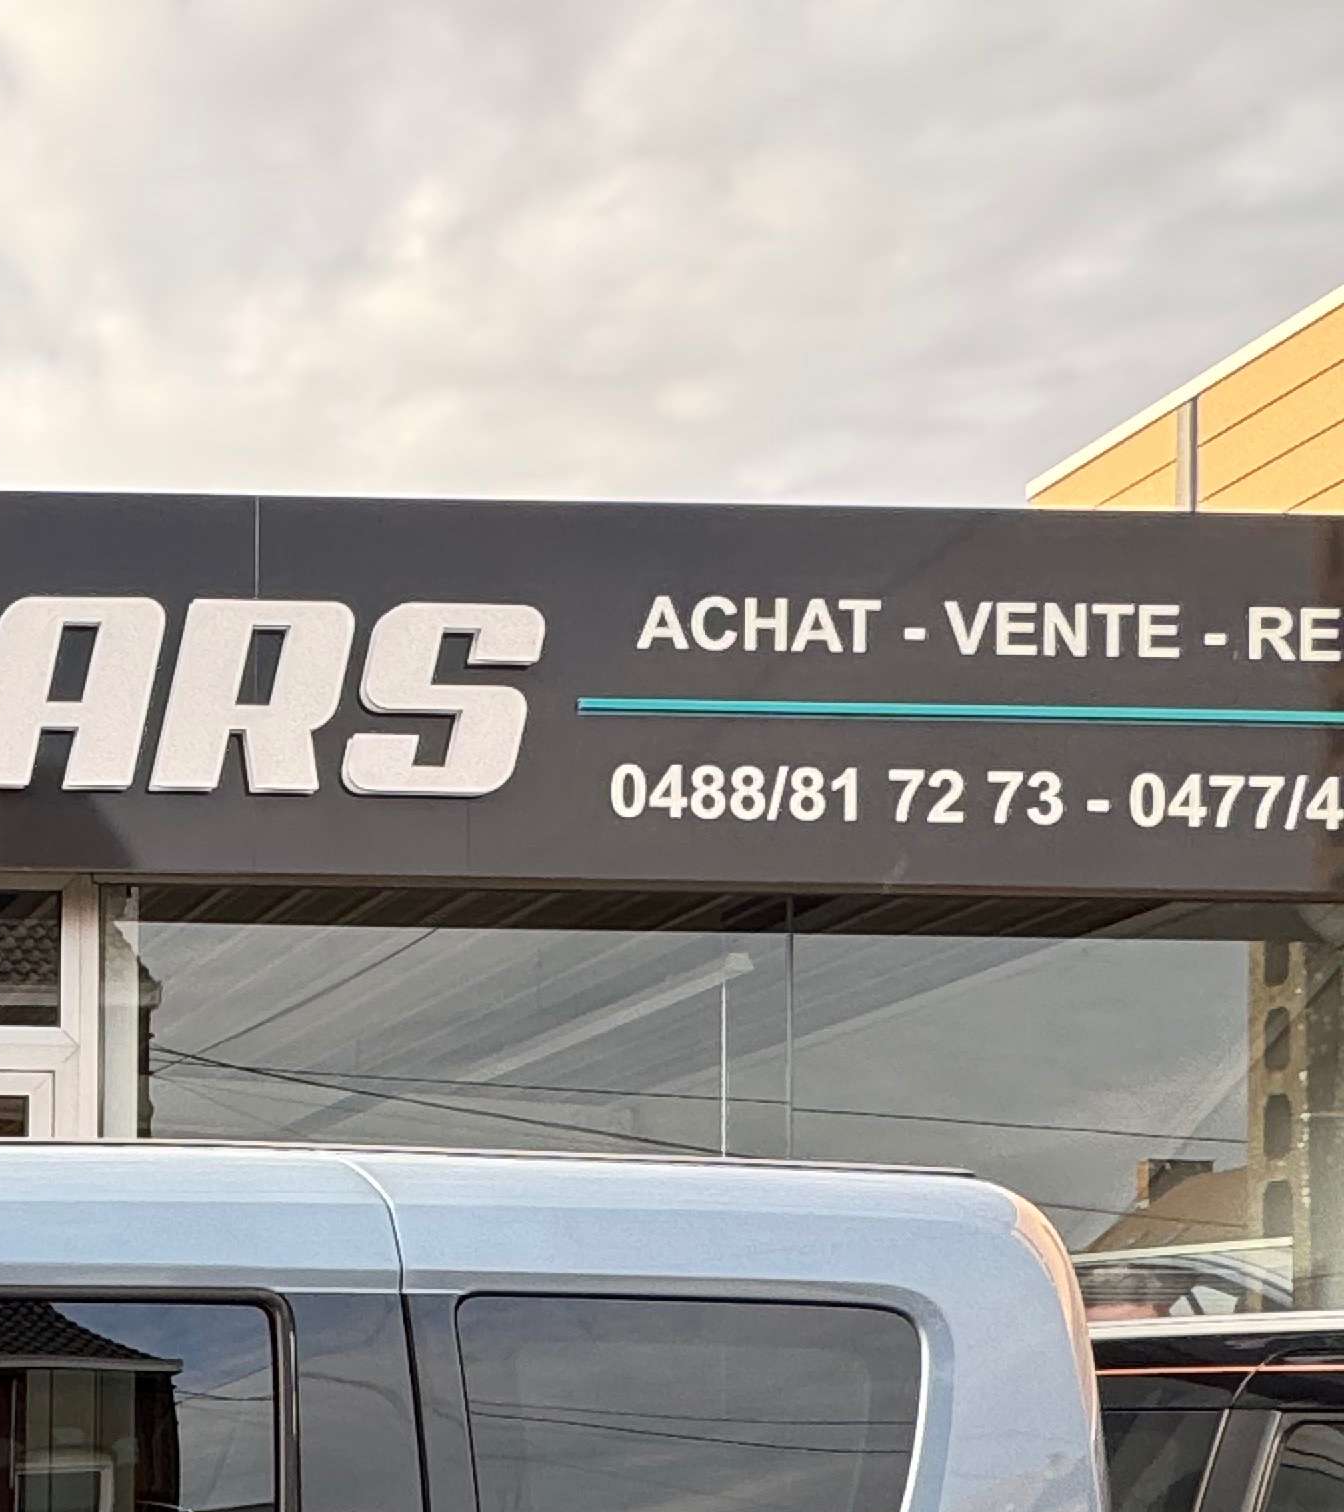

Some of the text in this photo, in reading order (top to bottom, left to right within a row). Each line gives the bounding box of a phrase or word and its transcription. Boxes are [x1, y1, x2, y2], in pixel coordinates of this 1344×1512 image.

[636, 595, 883, 654] ACHAT
[943, 600, 1181, 659] VENTE
[610, 763, 858, 822] 0488/81
[888, 768, 965, 824] 72
[986, 770, 1064, 826] 73
